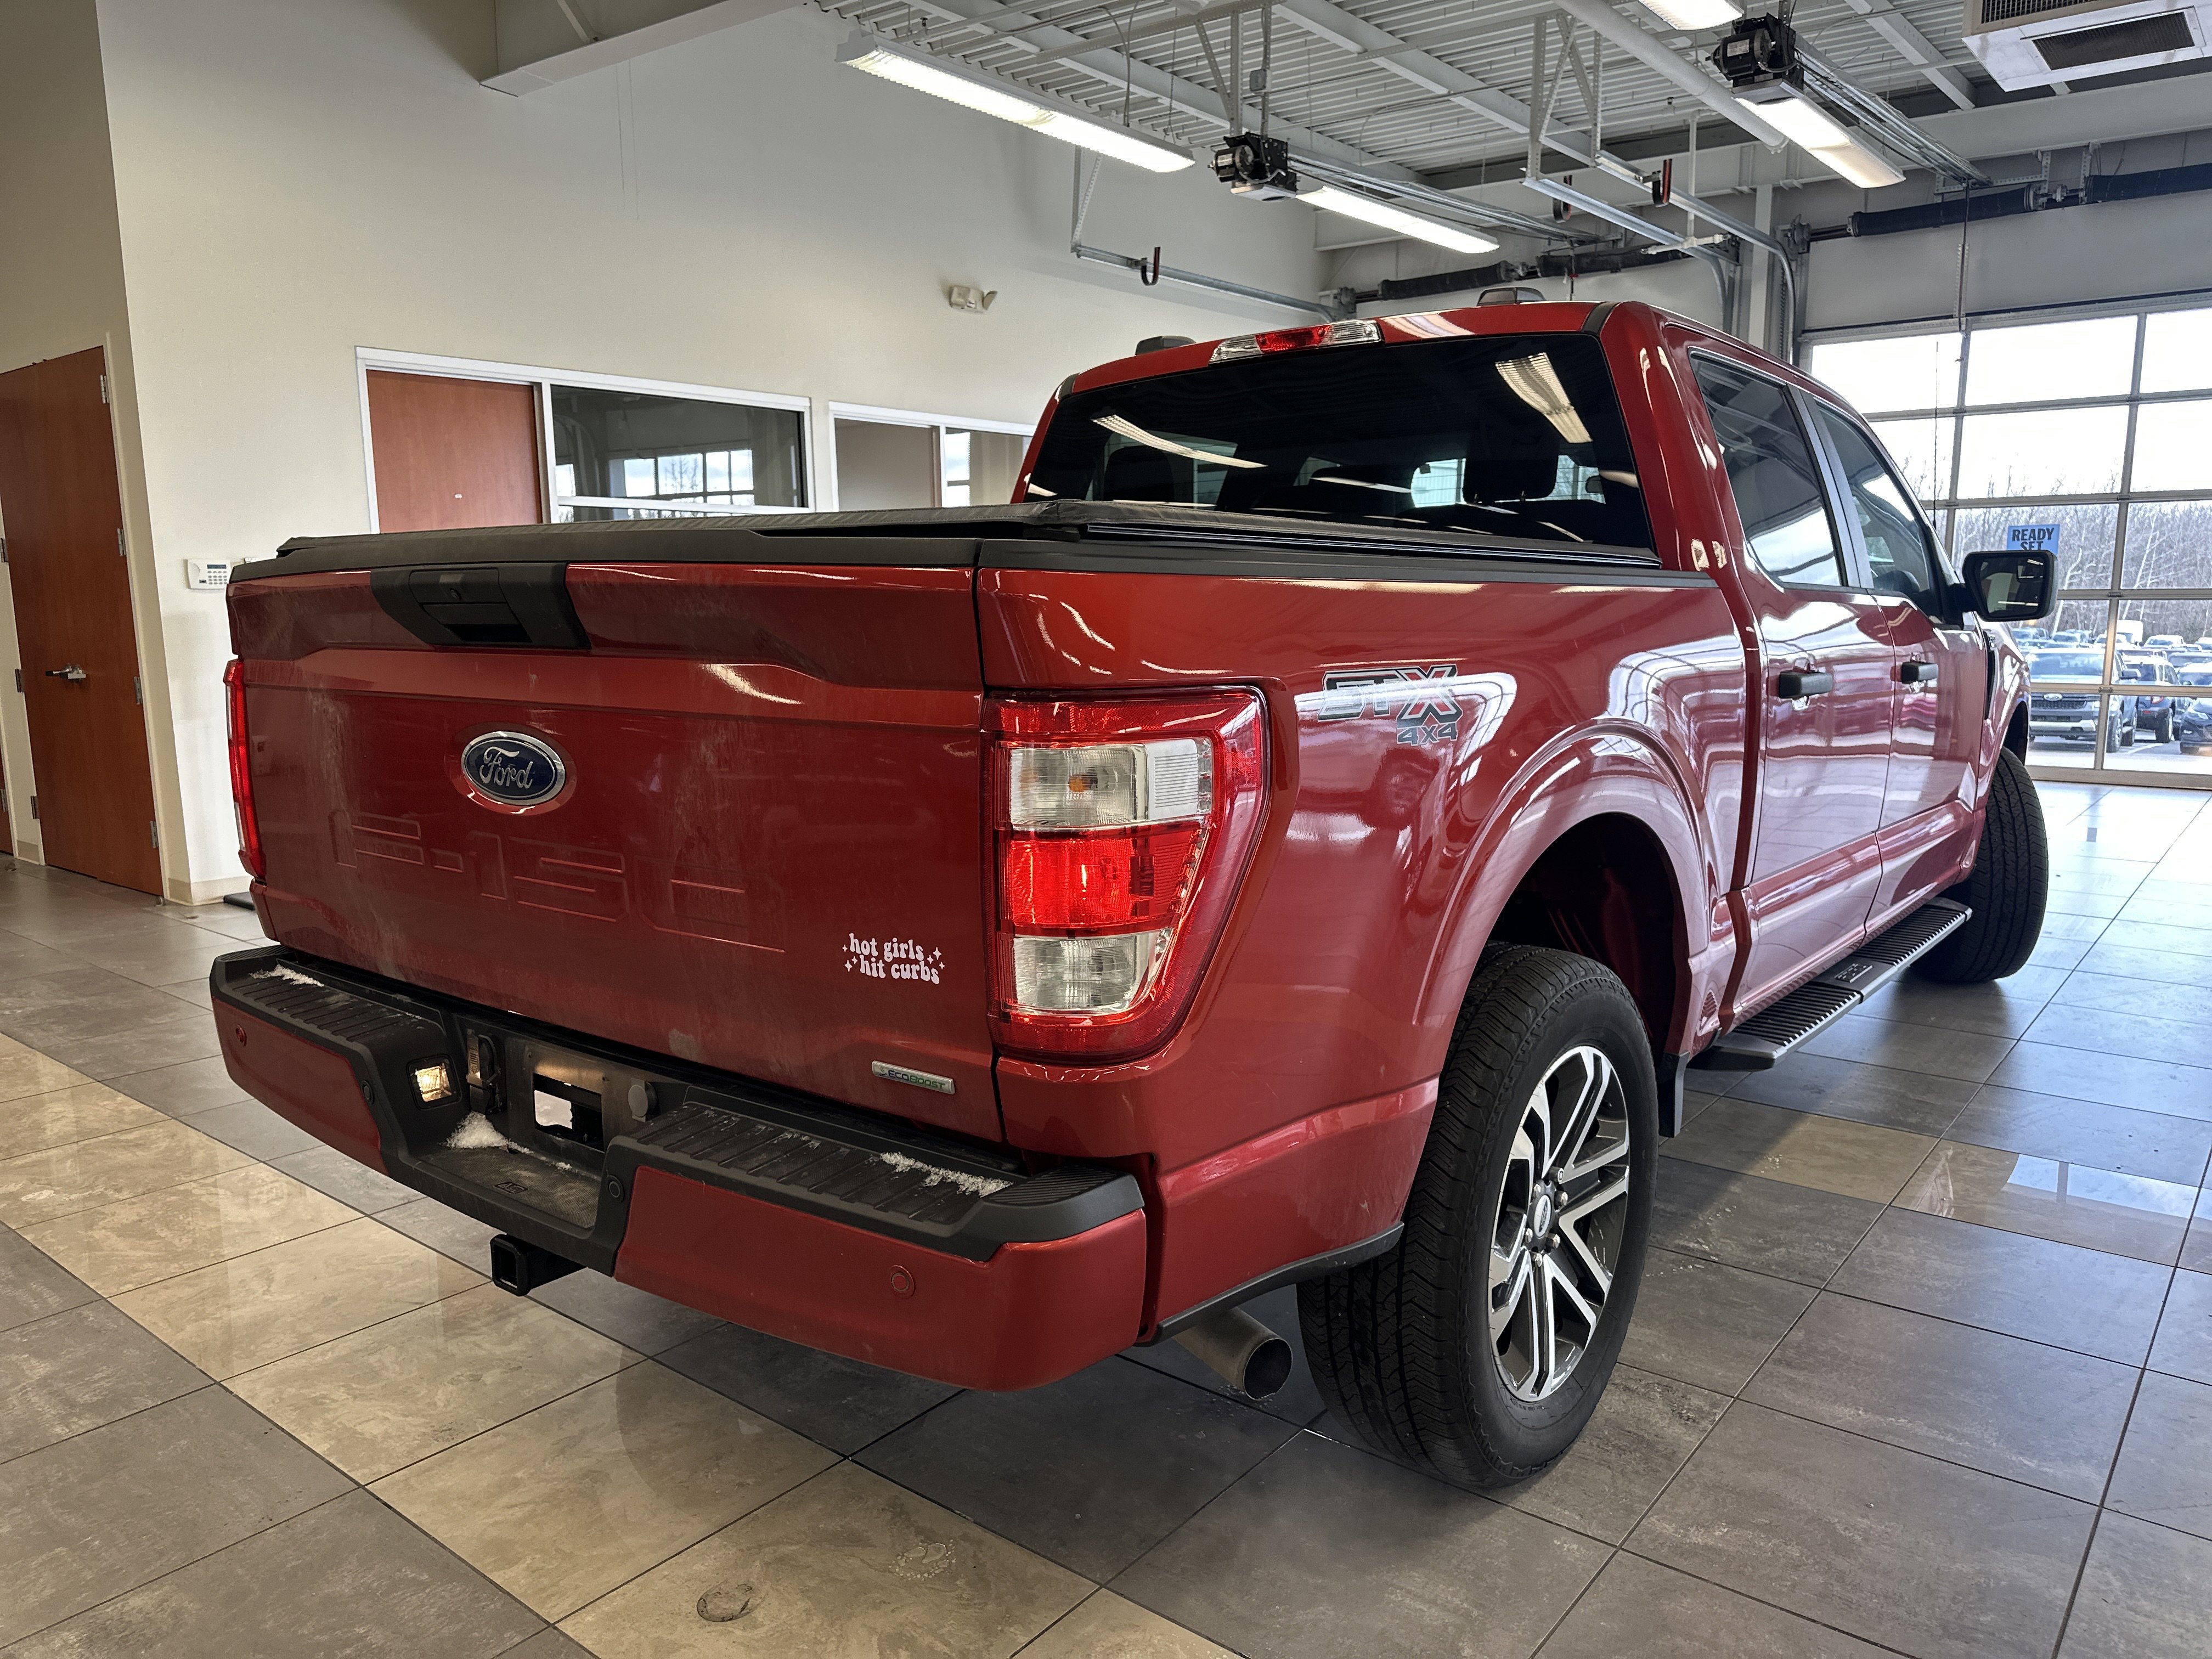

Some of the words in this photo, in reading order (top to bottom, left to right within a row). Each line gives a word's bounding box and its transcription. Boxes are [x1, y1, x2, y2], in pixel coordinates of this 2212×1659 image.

[2012, 528, 2054, 541] READY
[1317, 663, 1464, 729] STX
[479, 746, 534, 789] Ford
[849, 933, 878, 957] hot
[883, 937, 924, 962] girls
[859, 955, 886, 978] hit
[891, 961, 940, 985] curbs
[888, 1070, 945, 1089] ECOBOOST
